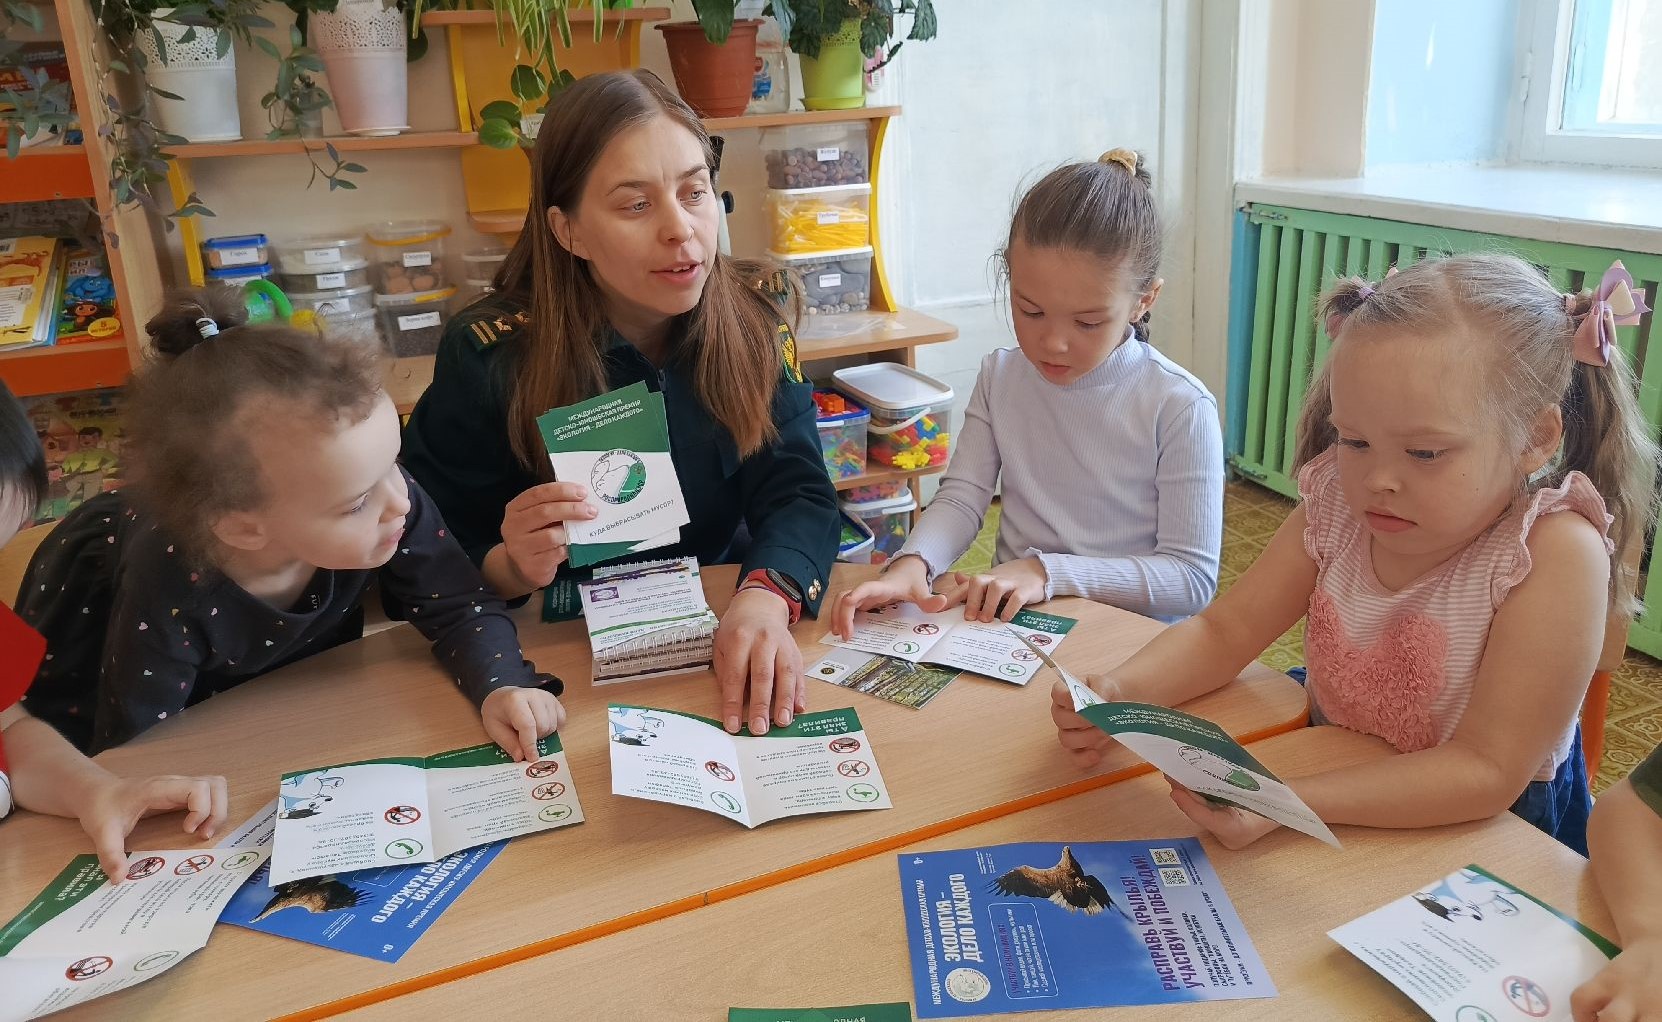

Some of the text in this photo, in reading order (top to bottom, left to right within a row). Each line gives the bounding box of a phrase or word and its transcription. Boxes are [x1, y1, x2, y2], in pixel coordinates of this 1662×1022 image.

[371, 874, 428, 924] КАЖДОГО
[949, 874, 974, 924] КАЖДОГО
[1130, 855, 1170, 915] ПОБЕЖДАЙ!
[936, 900, 961, 962] ЭКОЛОГИЯ
[959, 927, 984, 963] ДЕЛО
[1120, 877, 1180, 991] РАСПРАВЬ КРЫЛЬЯ!
[1157, 918, 1174, 926] И
[926, 950, 942, 1005] МЕЖДУНАРОДНАЯ
[1159, 930, 1205, 989] УЧАСТВУЙ
